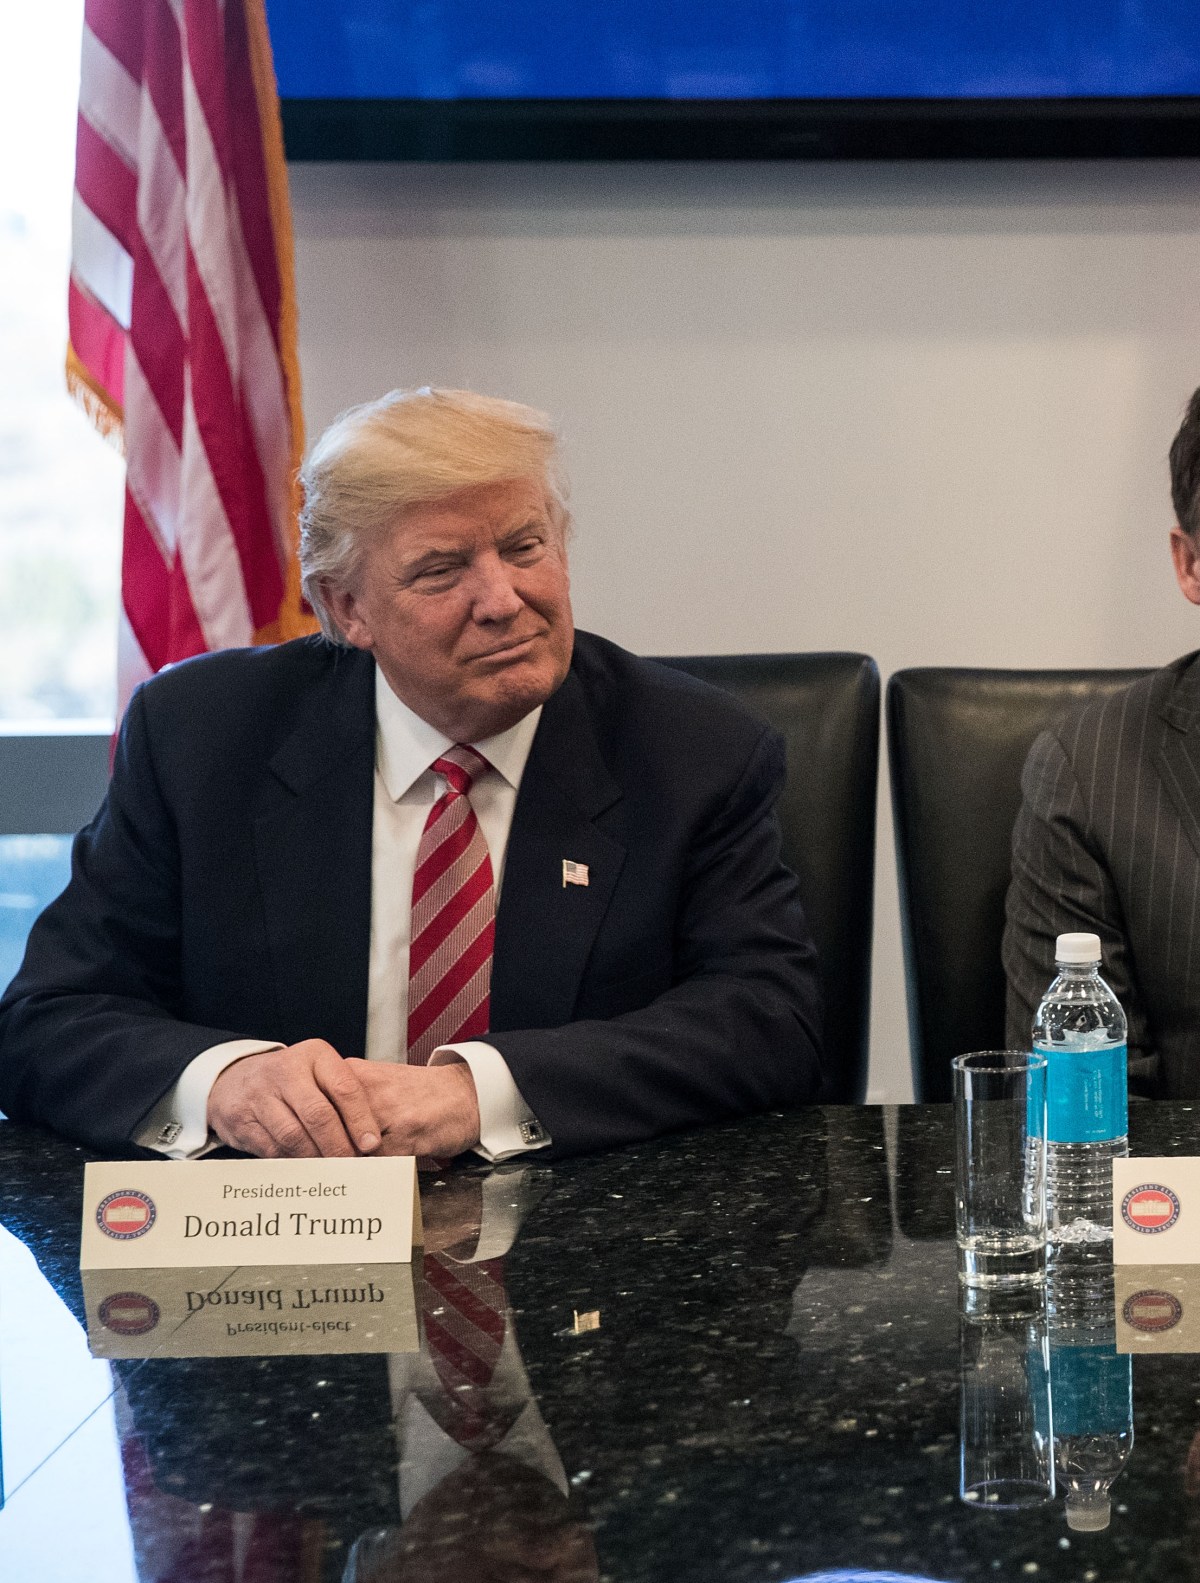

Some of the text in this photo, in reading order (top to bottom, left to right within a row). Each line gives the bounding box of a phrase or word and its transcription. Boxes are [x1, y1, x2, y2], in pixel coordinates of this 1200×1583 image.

[222, 1182, 347, 1199] President-elect
[184, 1212, 383, 1241] Donald Trump
